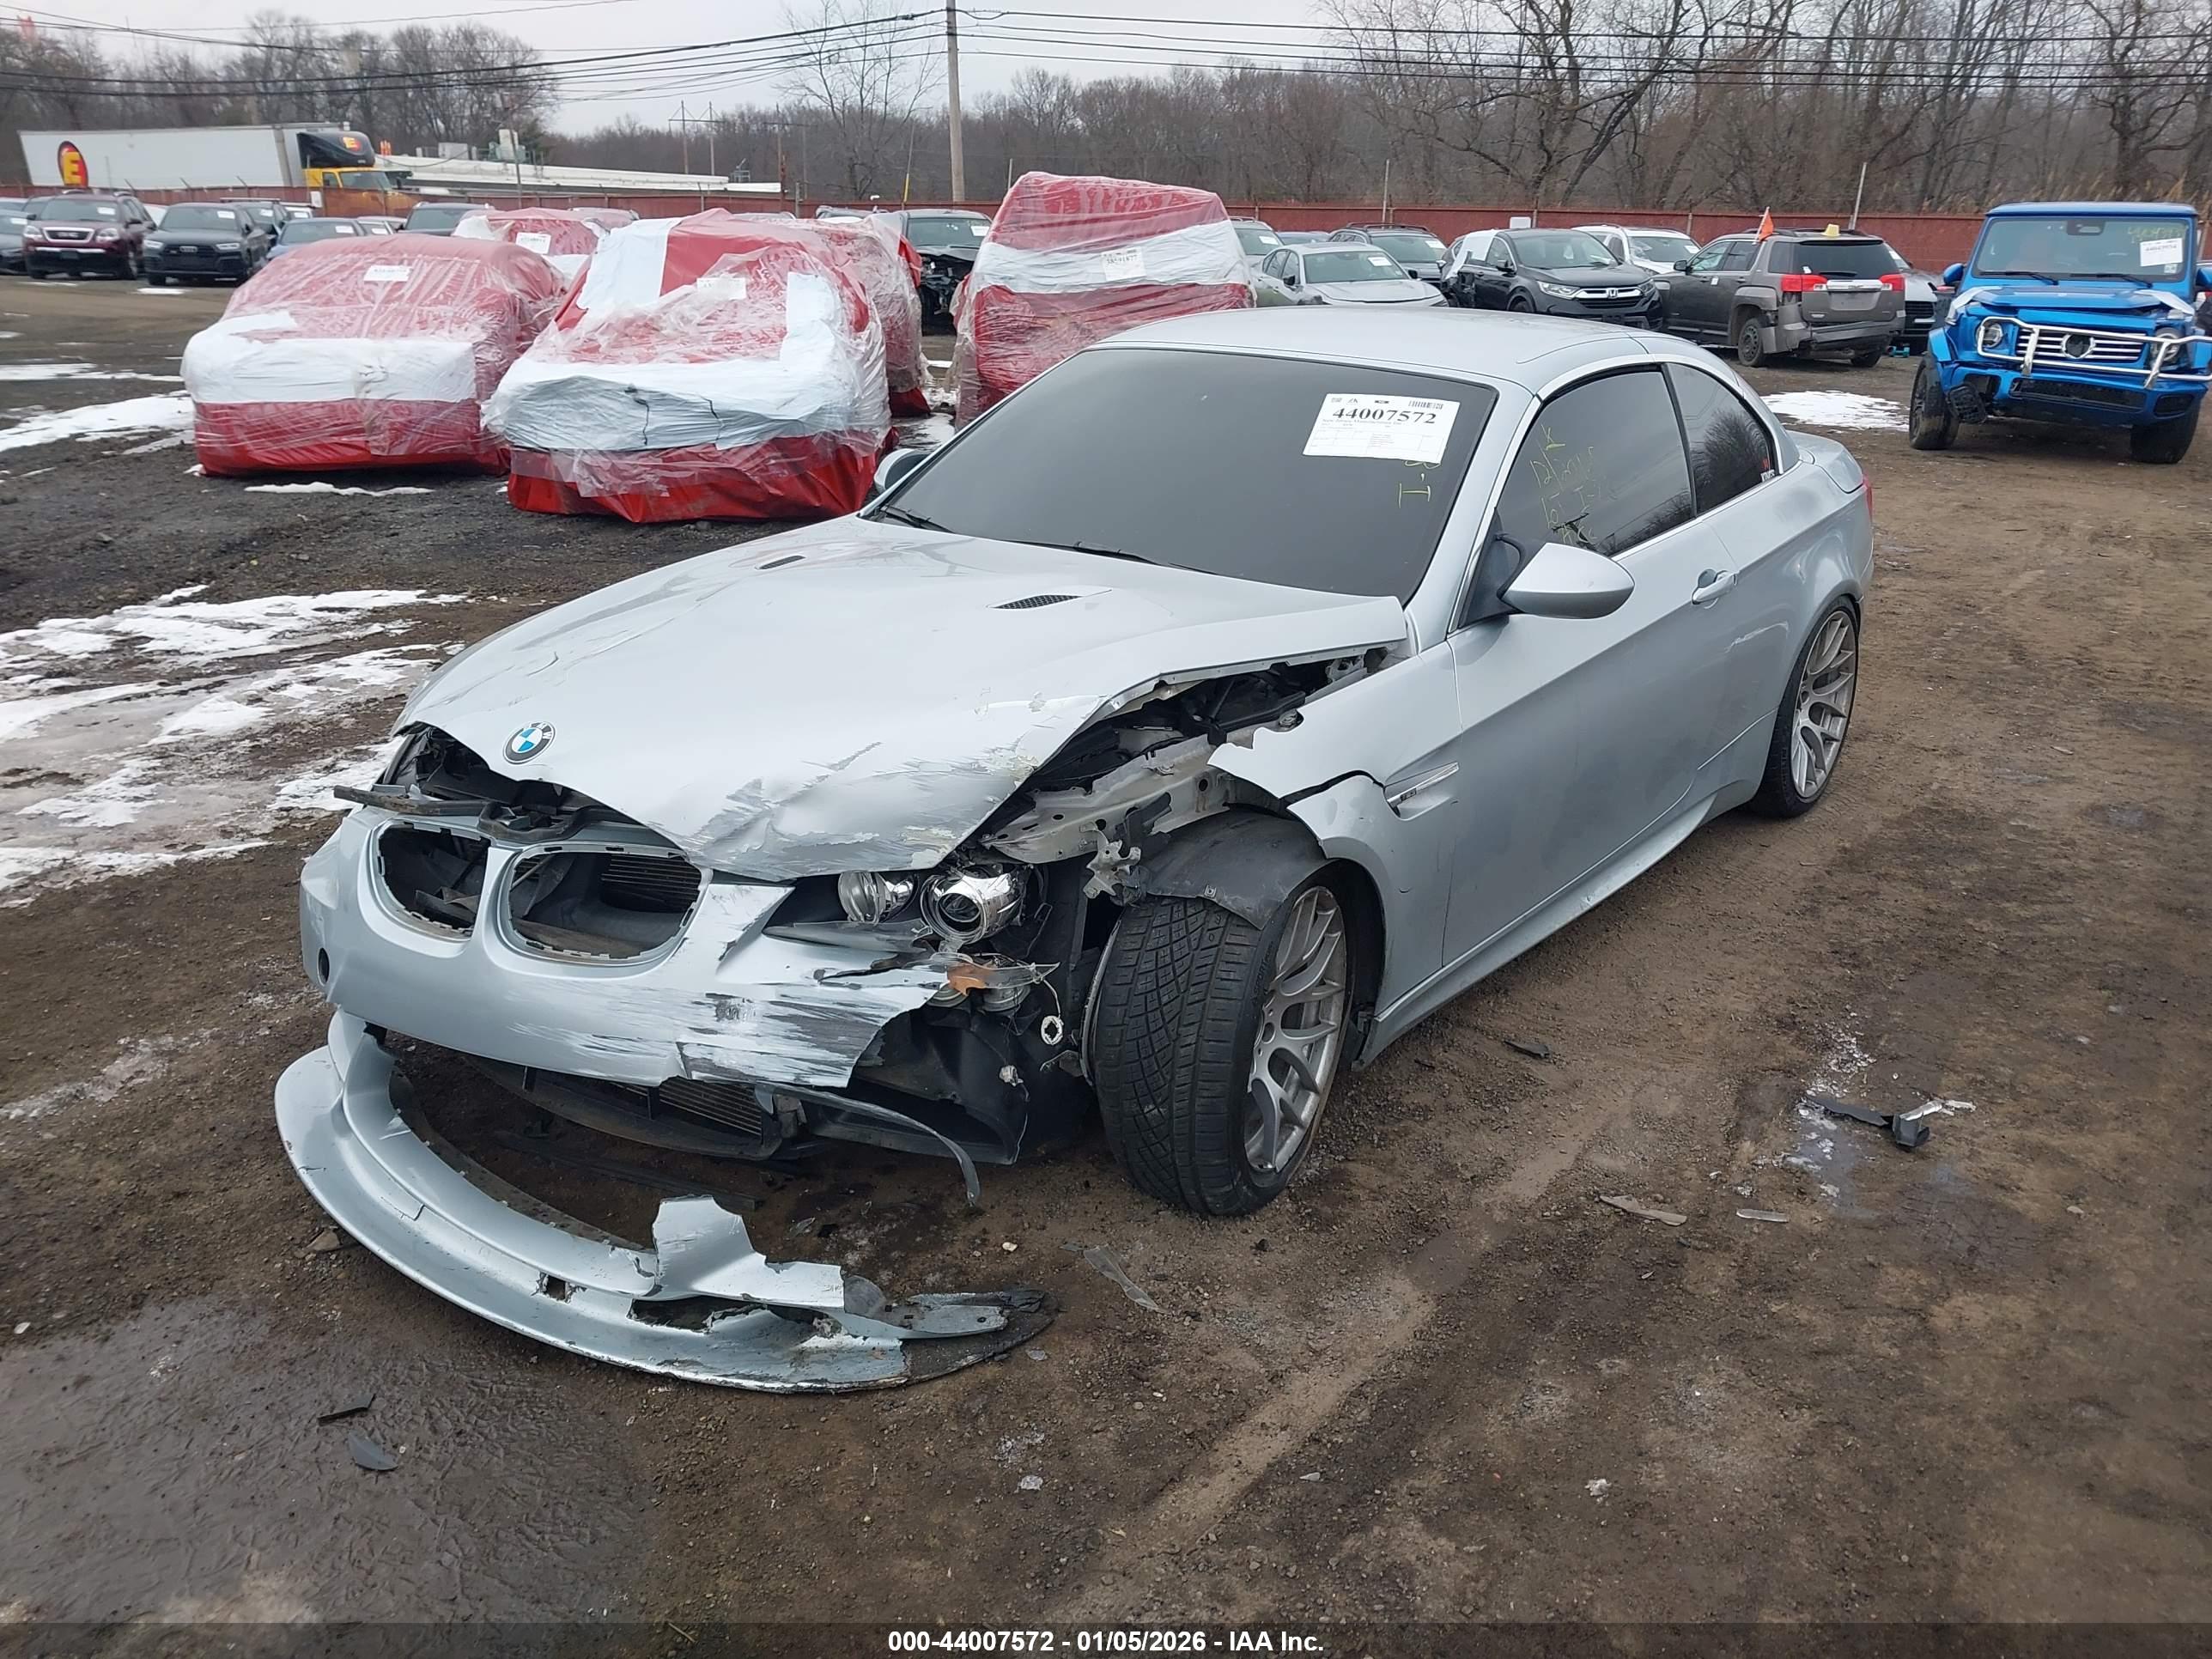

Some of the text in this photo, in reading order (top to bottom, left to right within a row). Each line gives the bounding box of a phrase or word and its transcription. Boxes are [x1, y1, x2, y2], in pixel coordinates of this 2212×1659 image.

[342, 137, 358, 149] E
[62, 151, 82, 185] E
[1332, 408, 1437, 424] 44007572
